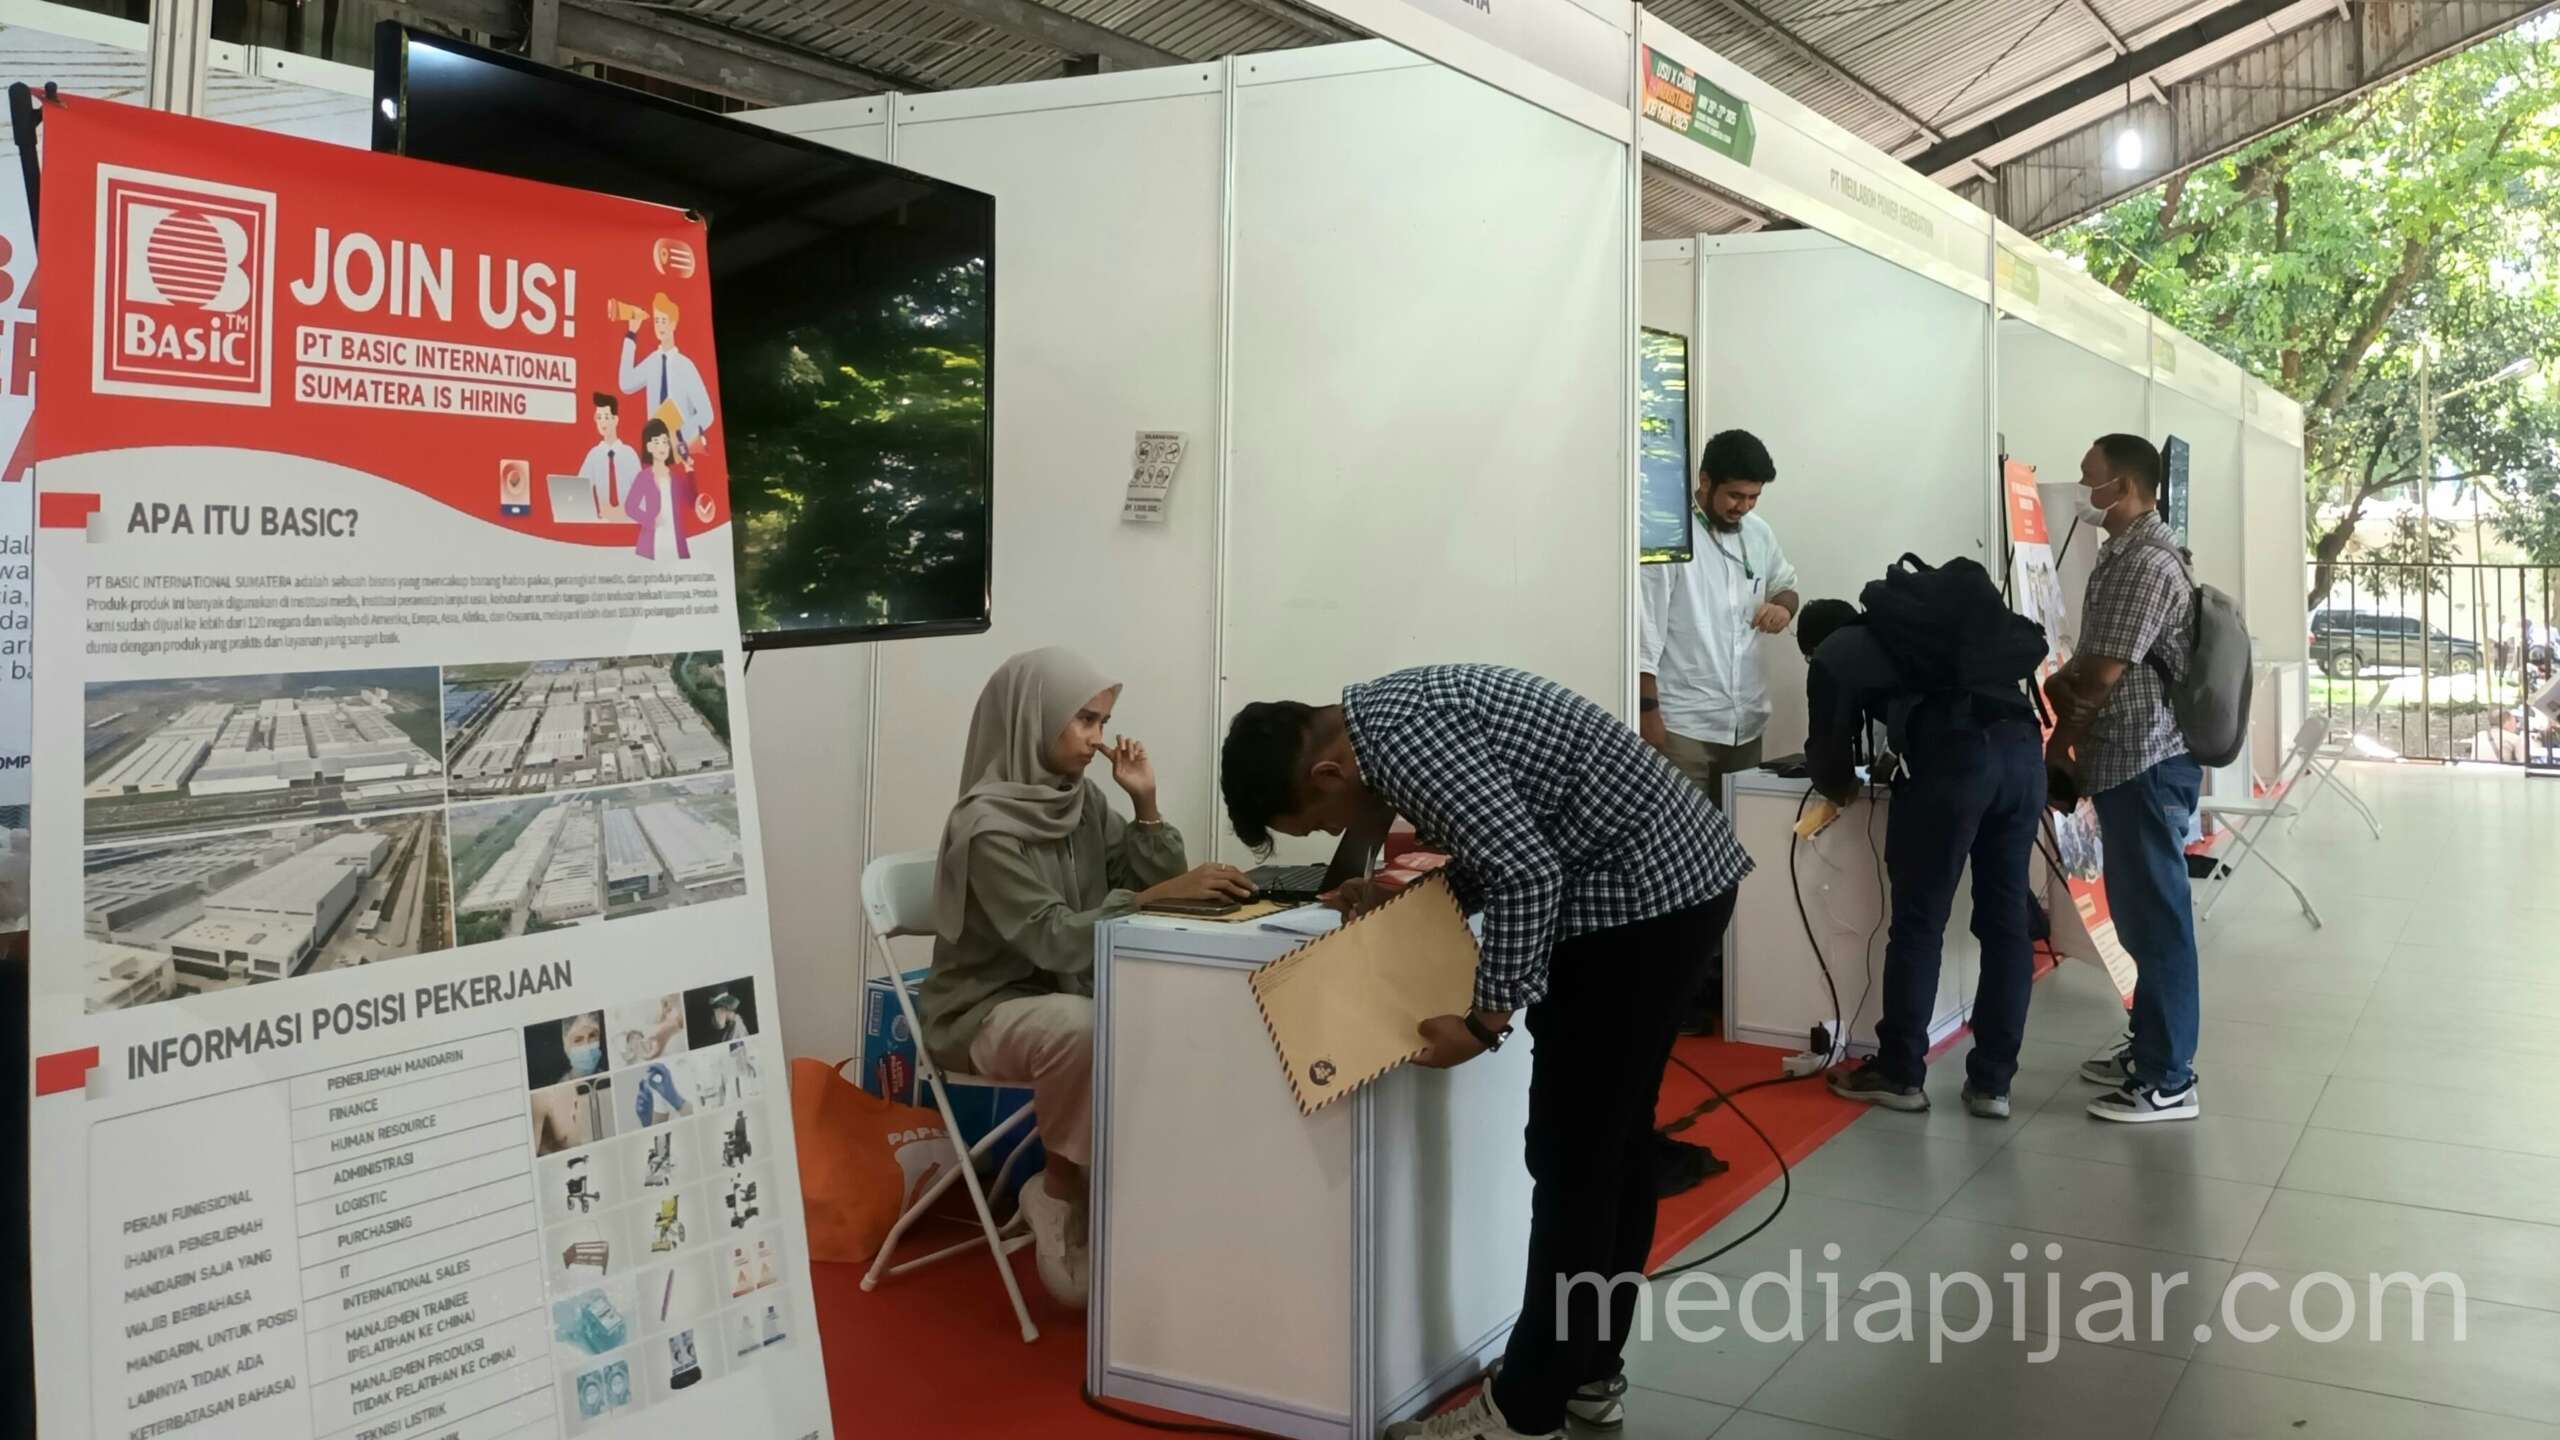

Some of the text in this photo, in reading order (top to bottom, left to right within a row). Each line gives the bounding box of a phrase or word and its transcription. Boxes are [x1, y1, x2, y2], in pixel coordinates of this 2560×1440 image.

[1830, 167, 1840, 190] PT
[289, 227, 576, 338] JOIN US!
[303, 331, 572, 383] PT BASIC INTERNATIONAL
[301, 374, 527, 415] SUMATERA IS HIRING
[127, 502, 359, 538] APA ITU BASIC?
[86, 575, 102, 589] PT
[105, 576, 140, 589] BASIC
[143, 575, 232, 589] INTERNATIONAL
[235, 575, 292, 588] SUMATERA
[128, 959, 574, 1079] INFORMASI POSISI PEKERJAAN
[327, 1049, 464, 1091] PENERJEMAH MANDARIN
[329, 1097, 379, 1122] FINANCE
[330, 1114, 437, 1152] HUMAN RESOURCE
[333, 1151, 415, 1185] ADMINISTRASI
[122, 1189, 254, 1236] PERAN FUNGSIONAL
[335, 1190, 388, 1216] LOGISTIC
[124, 1217, 264, 1271] (HANYA PENERJEMAH
[337, 1215, 413, 1248] PURCHASING
[123, 1248, 273, 1305] MANDARIN SAJA YANG
[339, 1263, 351, 1280] IT
[342, 1258, 471, 1311] INTERNATIONAL SALES
[124, 1288, 253, 1340] WAJIB BERBAHASA
[206, 1321, 253, 1348] UNTUK
[256, 1308, 298, 1333] POSISI
[345, 1290, 470, 1344] MANAJEMEN TRAINEE
[347, 1309, 476, 1363] (PELATIHAN KE CHINA)
[127, 1353, 265, 1411] LAINNYA TIDAK ADA
[350, 1337, 486, 1396] MANAJEMEN PRODUKSI
[352, 1344, 517, 1416] (TIDAK PELATIHAN KE CHINA)
[129, 1375, 297, 1440] KETERBATASAN BAHASA)
[404, 1401, 448, 1429] LISTRIK
